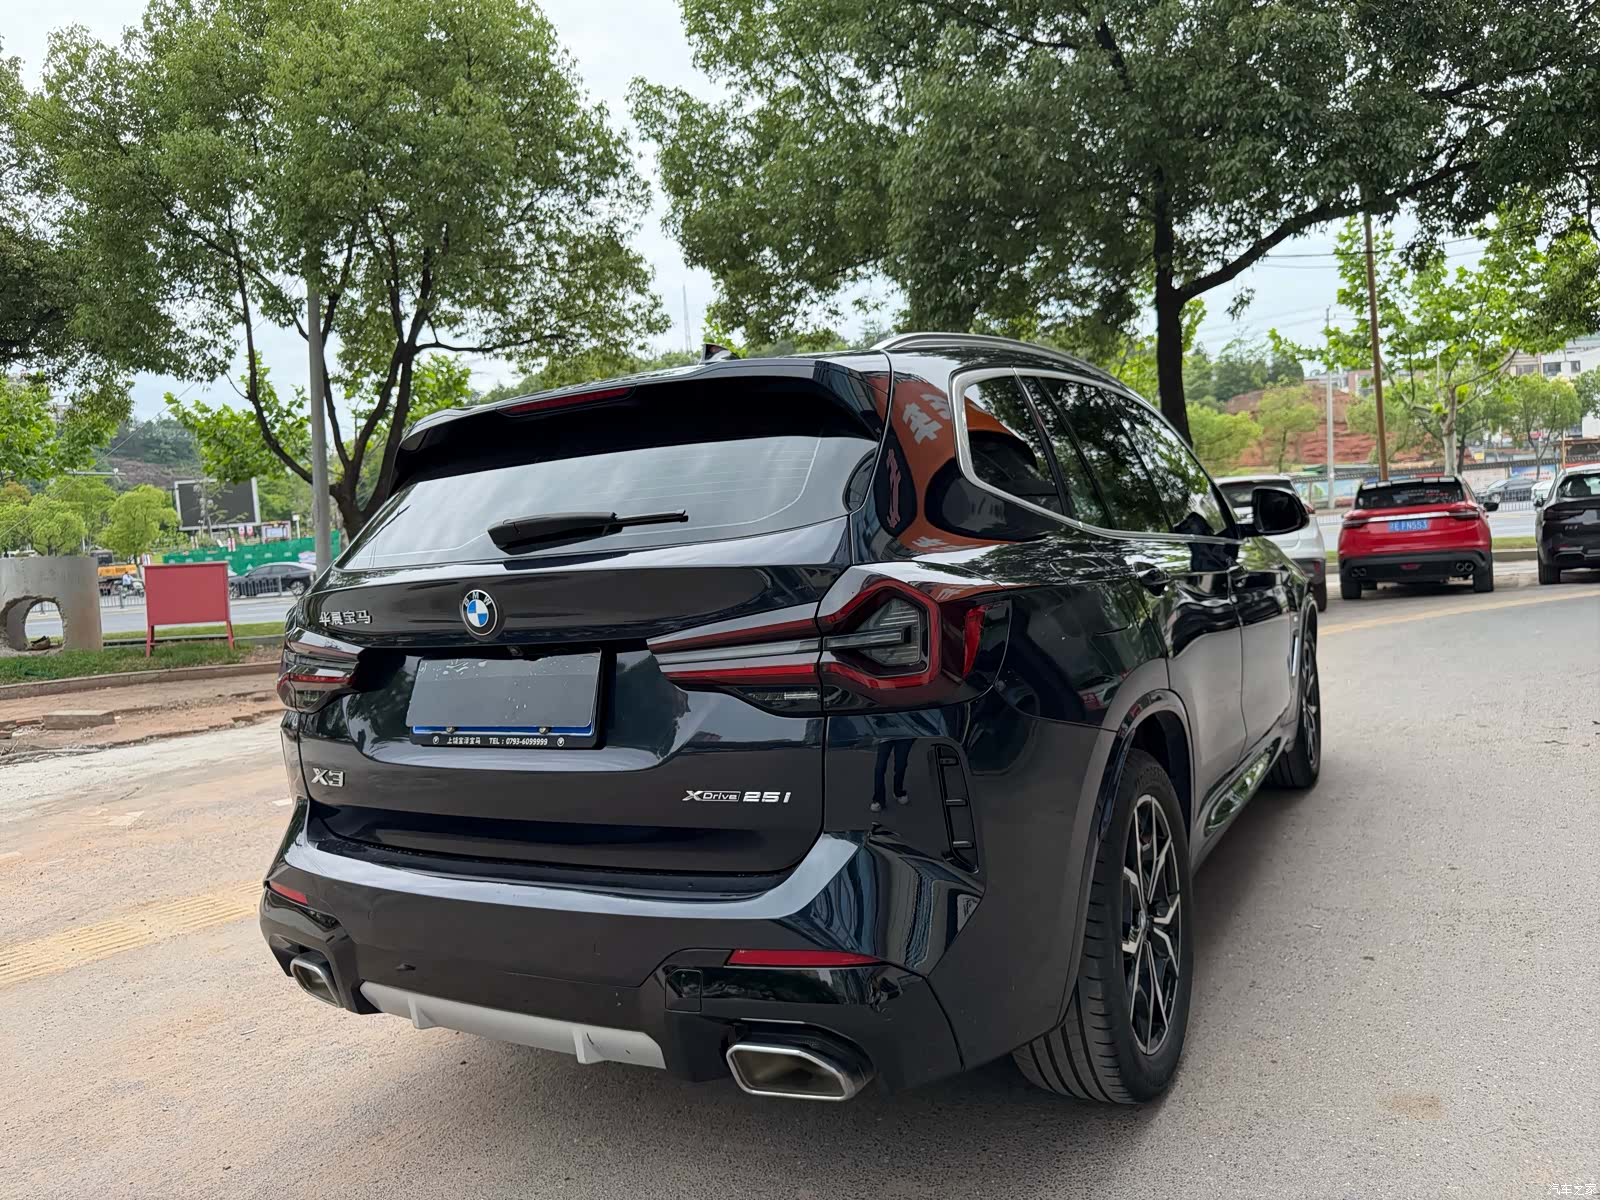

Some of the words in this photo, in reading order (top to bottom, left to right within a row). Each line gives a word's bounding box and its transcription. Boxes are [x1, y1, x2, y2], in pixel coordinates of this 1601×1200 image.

[464, 591, 492, 607] BMW
[319, 610, 371, 626] 华晨宝马
[311, 767, 345, 787] X3
